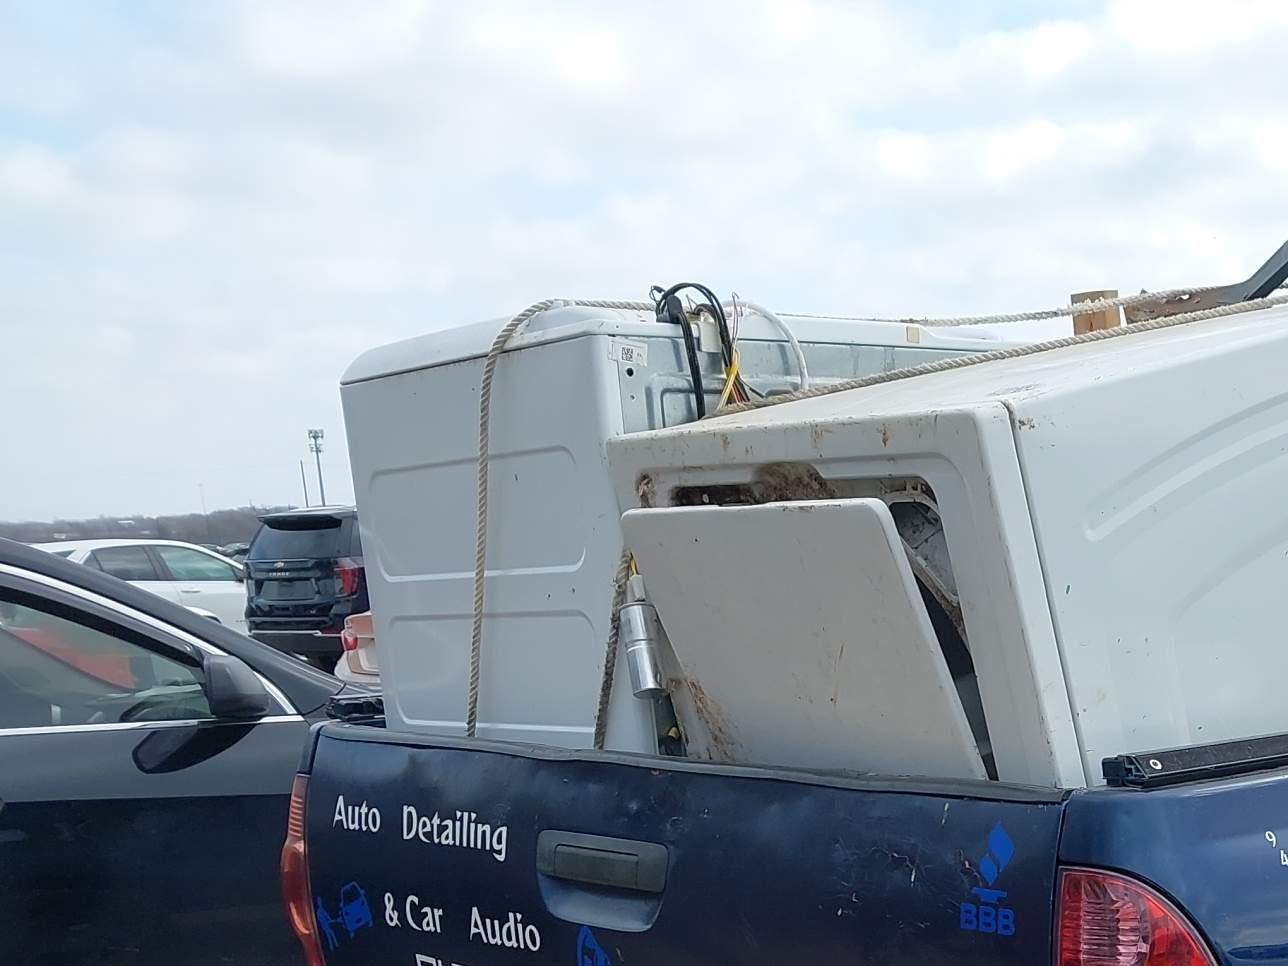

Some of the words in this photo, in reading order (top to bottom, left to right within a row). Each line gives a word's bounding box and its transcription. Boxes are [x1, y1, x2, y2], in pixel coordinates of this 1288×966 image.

[333, 795, 381, 833] Auto
[402, 805, 508, 862] Detailing
[384, 892, 402, 928] &
[405, 895, 443, 933] Car
[470, 906, 541, 951] Audio
[960, 902, 1016, 936] BBB
